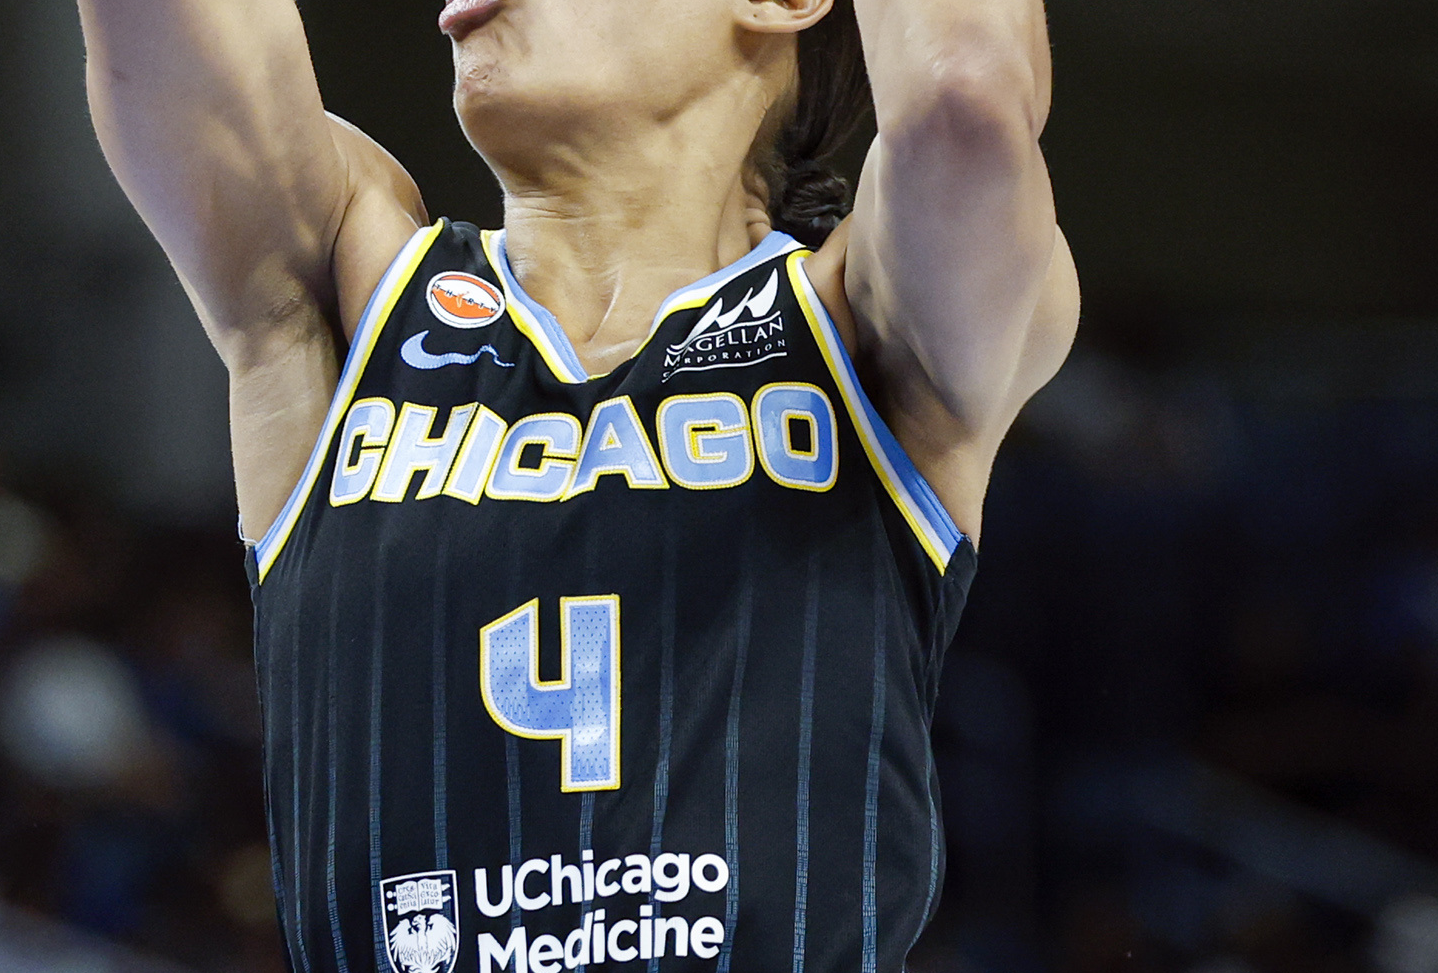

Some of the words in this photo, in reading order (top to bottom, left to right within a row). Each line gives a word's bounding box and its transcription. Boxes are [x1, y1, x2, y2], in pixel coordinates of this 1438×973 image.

[662, 339, 787, 378] CRPORATION
[329, 382, 840, 508] CHICAGO
[479, 593, 622, 794] 4
[474, 849, 730, 918] UChicago
[477, 904, 725, 973] Medicine
